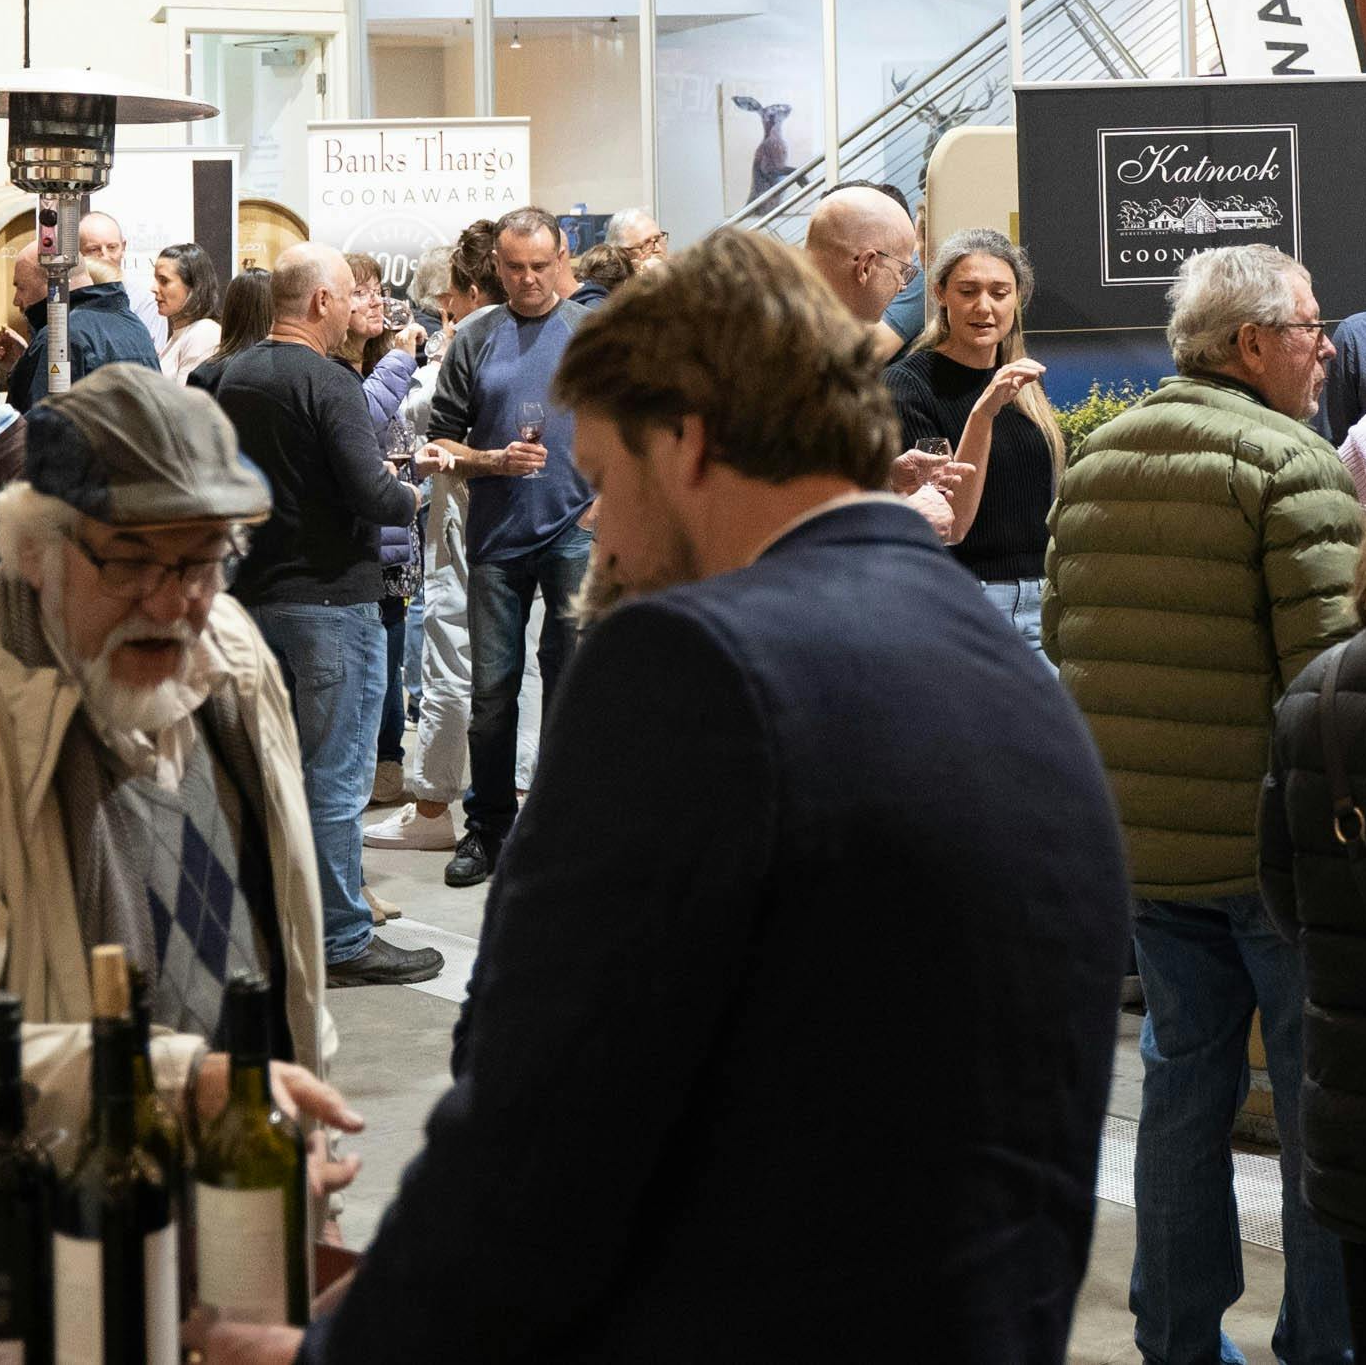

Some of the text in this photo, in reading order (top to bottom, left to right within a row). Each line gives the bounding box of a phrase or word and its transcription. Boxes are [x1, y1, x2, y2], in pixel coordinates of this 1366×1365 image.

[323, 131, 407, 173] Banks
[415, 130, 514, 180] Thargo
[1117, 144, 1281, 184] Katnook
[322, 187, 515, 206] COONAWARRA
[371, 251, 419, 286] 00
